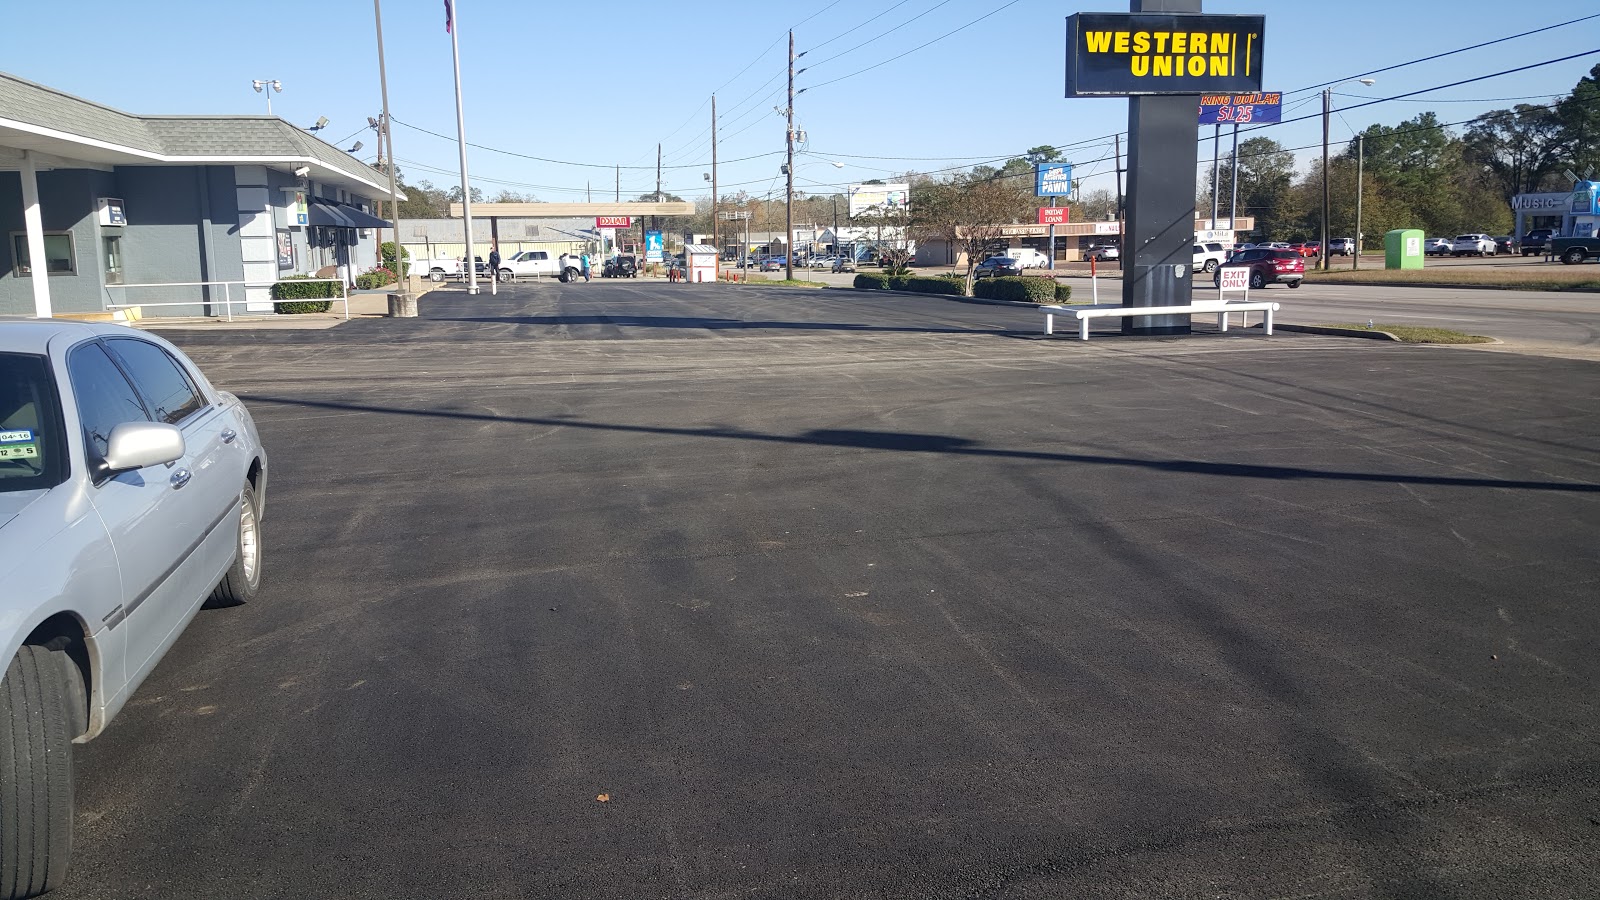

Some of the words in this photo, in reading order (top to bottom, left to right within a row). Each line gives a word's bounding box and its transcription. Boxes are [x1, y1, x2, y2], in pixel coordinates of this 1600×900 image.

[1085, 31, 1230, 54] WESTERN
[1130, 55, 1229, 77] UNION
[1200, 95, 1231, 106] KING
[1233, 93, 1280, 105] DOLLAR
[1217, 106, 1253, 123] $1.25
[1041, 180, 1068, 193] PAWN
[1511, 196, 1555, 209] MUSIC
[1223, 271, 1247, 280] EXIT
[1222, 280, 1247, 288] ONLY
